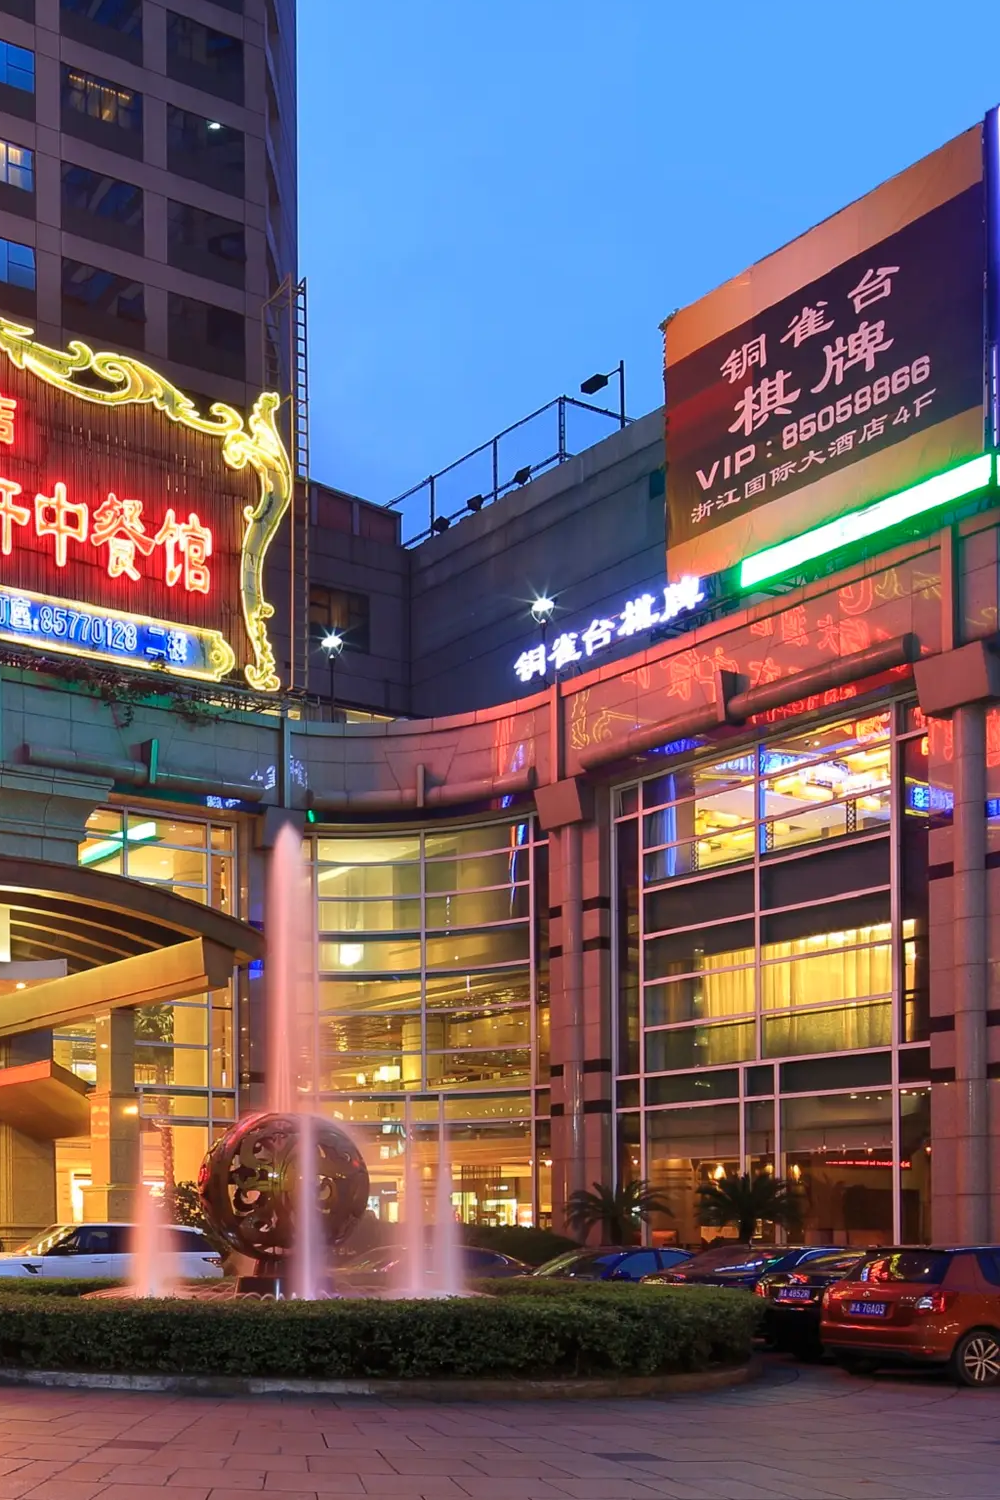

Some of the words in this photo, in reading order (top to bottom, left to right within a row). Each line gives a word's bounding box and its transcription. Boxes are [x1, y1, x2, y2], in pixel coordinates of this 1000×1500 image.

[720, 266, 900, 384] 铜雀台
[728, 320, 894, 437] 棋牌
[782, 355, 931, 451] 85058866
